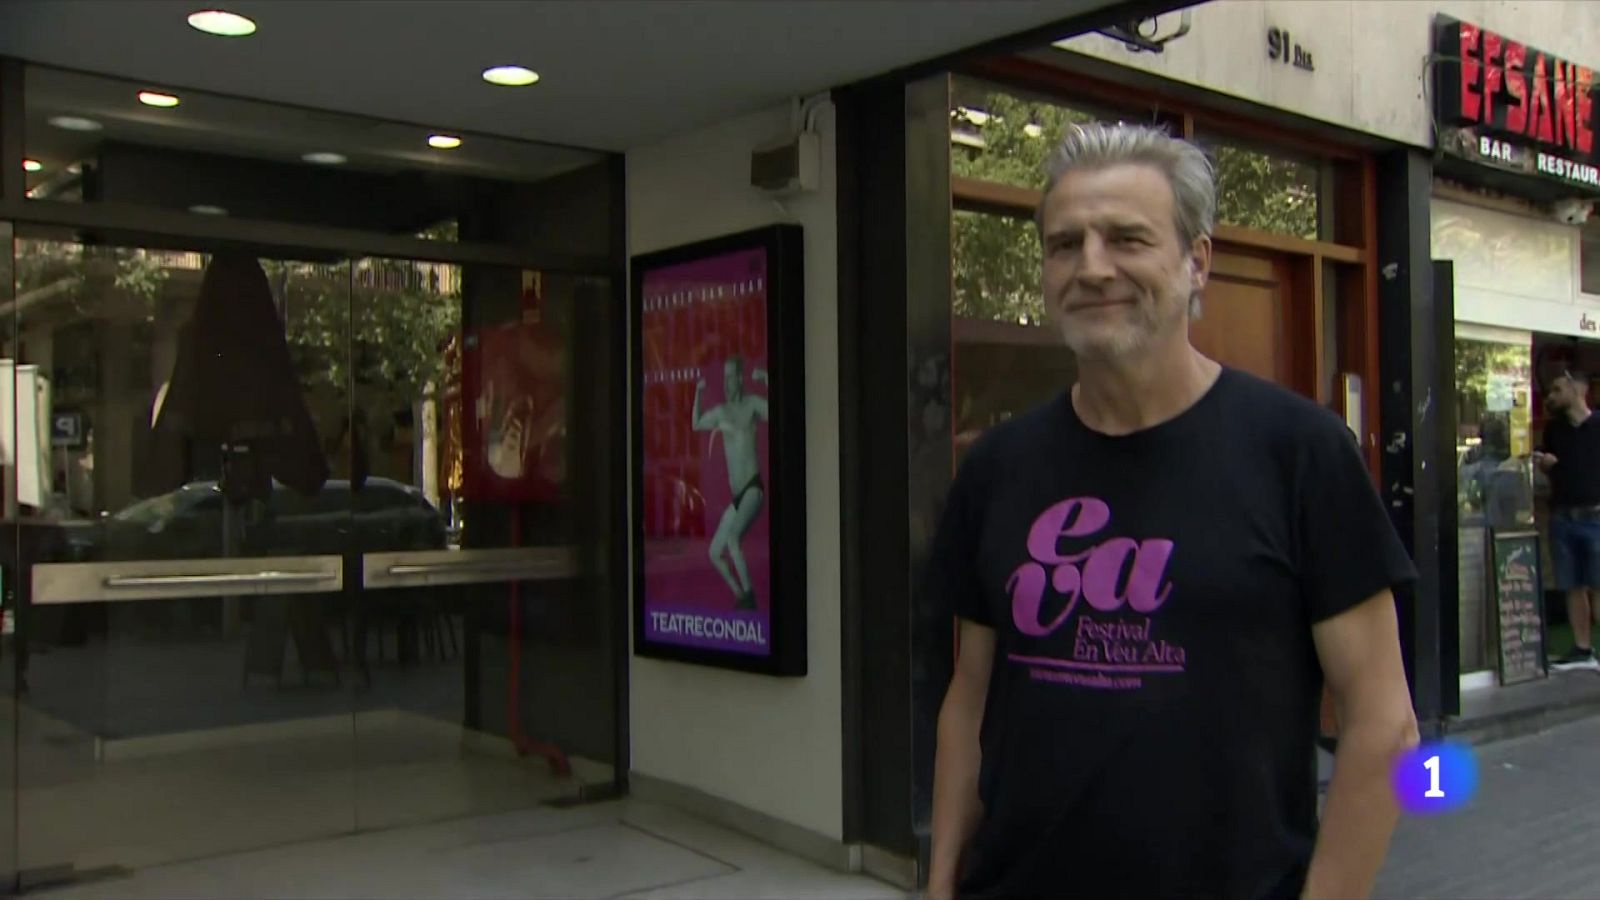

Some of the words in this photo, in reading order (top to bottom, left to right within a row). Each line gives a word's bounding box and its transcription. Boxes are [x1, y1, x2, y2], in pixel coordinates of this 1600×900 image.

[1268, 27, 1290, 64] 91
[1460, 21, 1594, 154] EFSANE
[1480, 136, 1512, 161] BAR
[1537, 152, 1600, 186] RESTAUR
[1579, 312, 1597, 331] des
[651, 611, 766, 645] TEATRECONDAL
[1077, 615, 1151, 640] Festival
[1074, 637, 1099, 661] En
[1102, 639, 1138, 662] Veu
[1143, 640, 1186, 664] Alta
